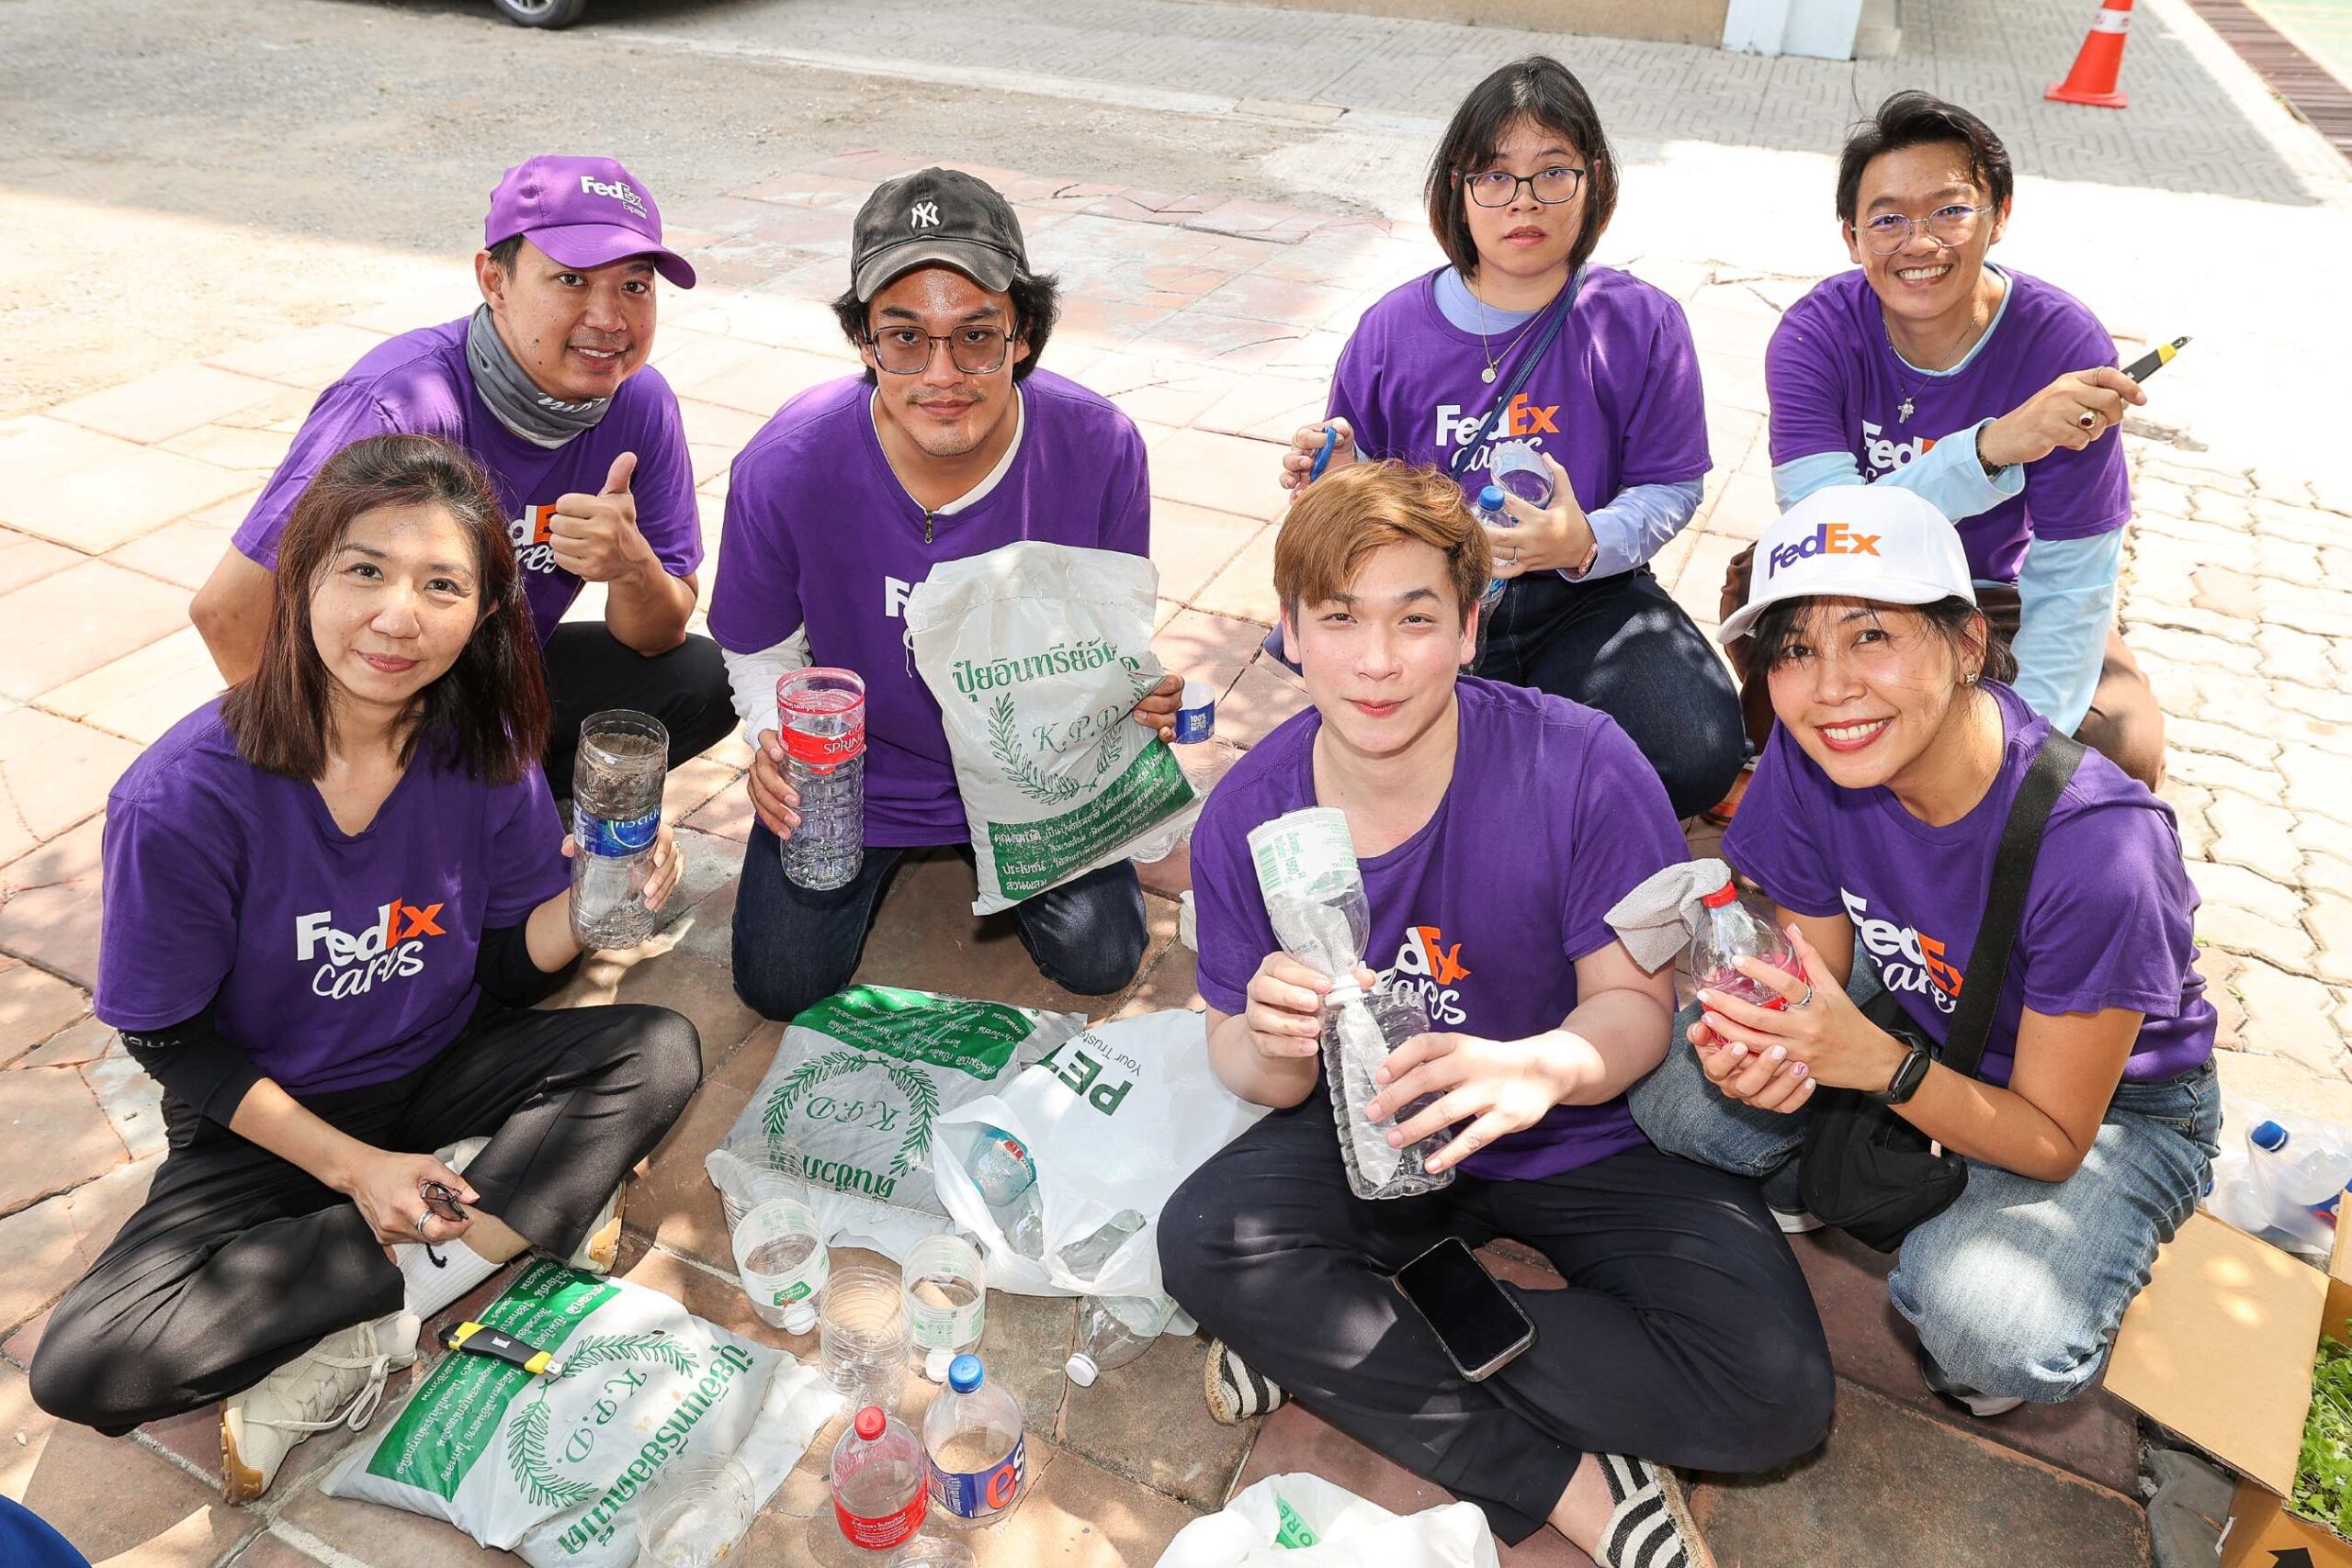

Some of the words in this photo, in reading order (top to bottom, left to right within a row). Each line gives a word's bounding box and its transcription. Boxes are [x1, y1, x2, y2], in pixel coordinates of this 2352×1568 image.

[580, 175, 644, 209] FedEx
[911, 201, 940, 228] NY
[1769, 524, 1882, 580] FedEx
[1114, 1053, 1141, 1077] Your
